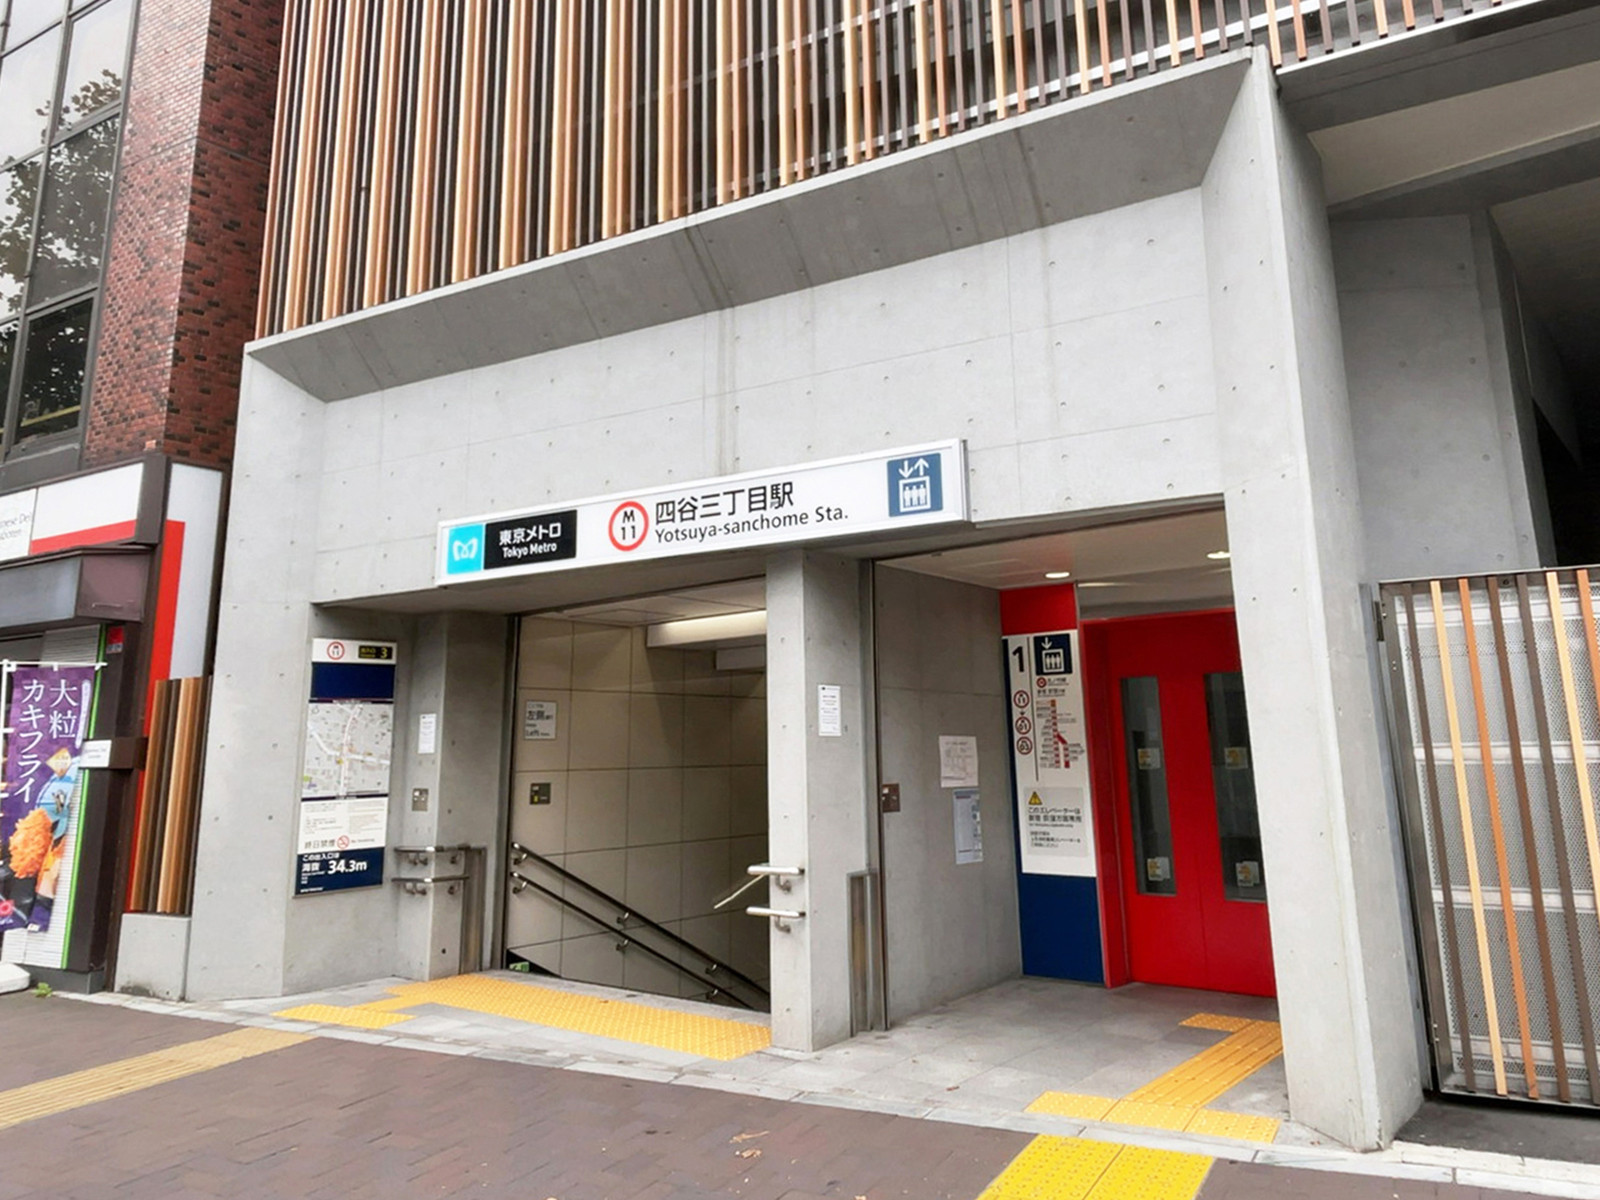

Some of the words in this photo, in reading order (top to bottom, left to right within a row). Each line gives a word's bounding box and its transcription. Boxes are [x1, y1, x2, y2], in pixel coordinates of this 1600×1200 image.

[655, 481, 795, 525] 四谷三丁目駅
[622, 510, 636, 523] M
[655, 510, 809, 543] Yotsuya-sanchome
[815, 505, 849, 524] Sta.
[499, 522, 561, 546] 東京メトロ
[621, 525, 636, 540] 11
[502, 546, 529, 560] Tokyo
[529, 541, 558, 555] Metro
[380, 647, 388, 659] 3
[1012, 646, 1025, 673] 1
[49, 679, 79, 739] 大粒
[14, 679, 45, 803] カキフライ
[327, 859, 367, 875] 34.3m
